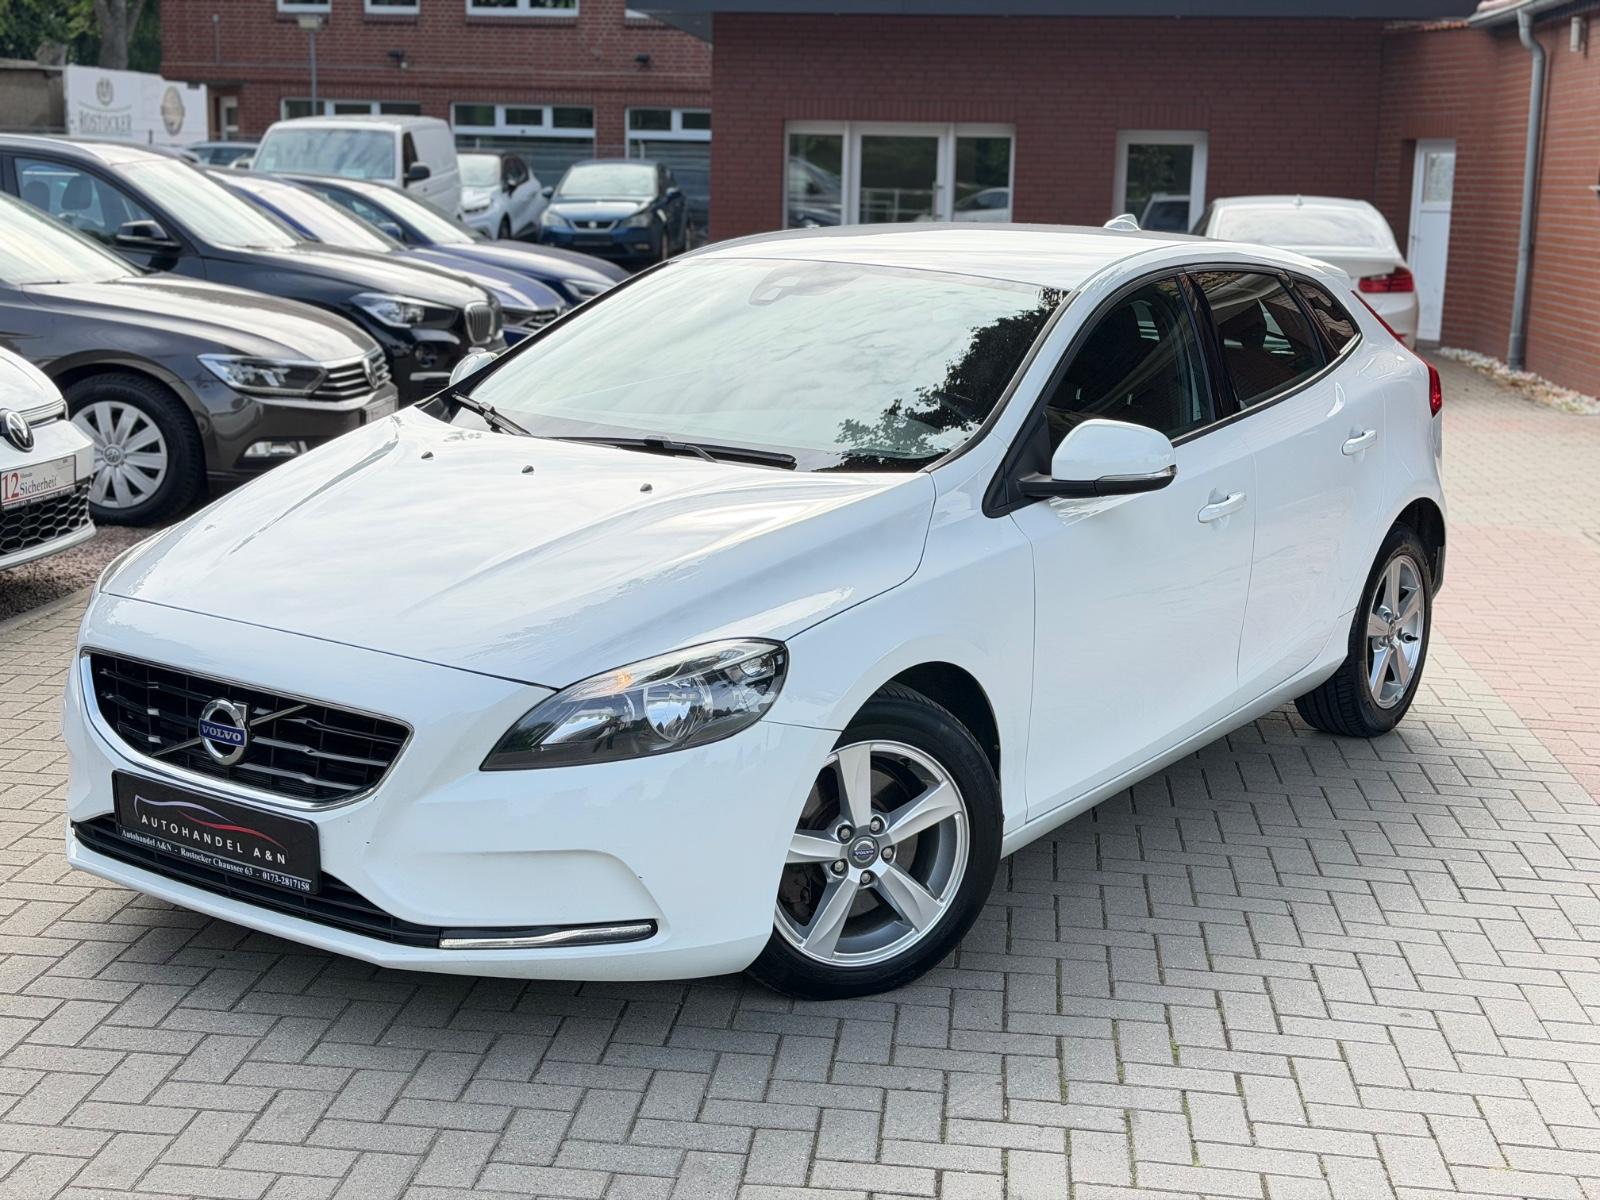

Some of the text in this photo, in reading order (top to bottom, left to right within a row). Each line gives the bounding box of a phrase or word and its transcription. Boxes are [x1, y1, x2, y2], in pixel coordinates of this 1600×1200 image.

[2, 472, 20, 500] 12
[20, 475, 57, 496] Sicherheit
[201, 724, 242, 742] VOLVO
[141, 814, 286, 865] AUTOHANDEL A&N
[121, 829, 156, 847] Autohandel
[156, 841, 172, 852] A&N
[180, 847, 211, 865] Rostocker
[213, 860, 244, 874] Chaussee
[244, 867, 253, 876] 63
[262, 871, 310, 891] 0173-2817158
